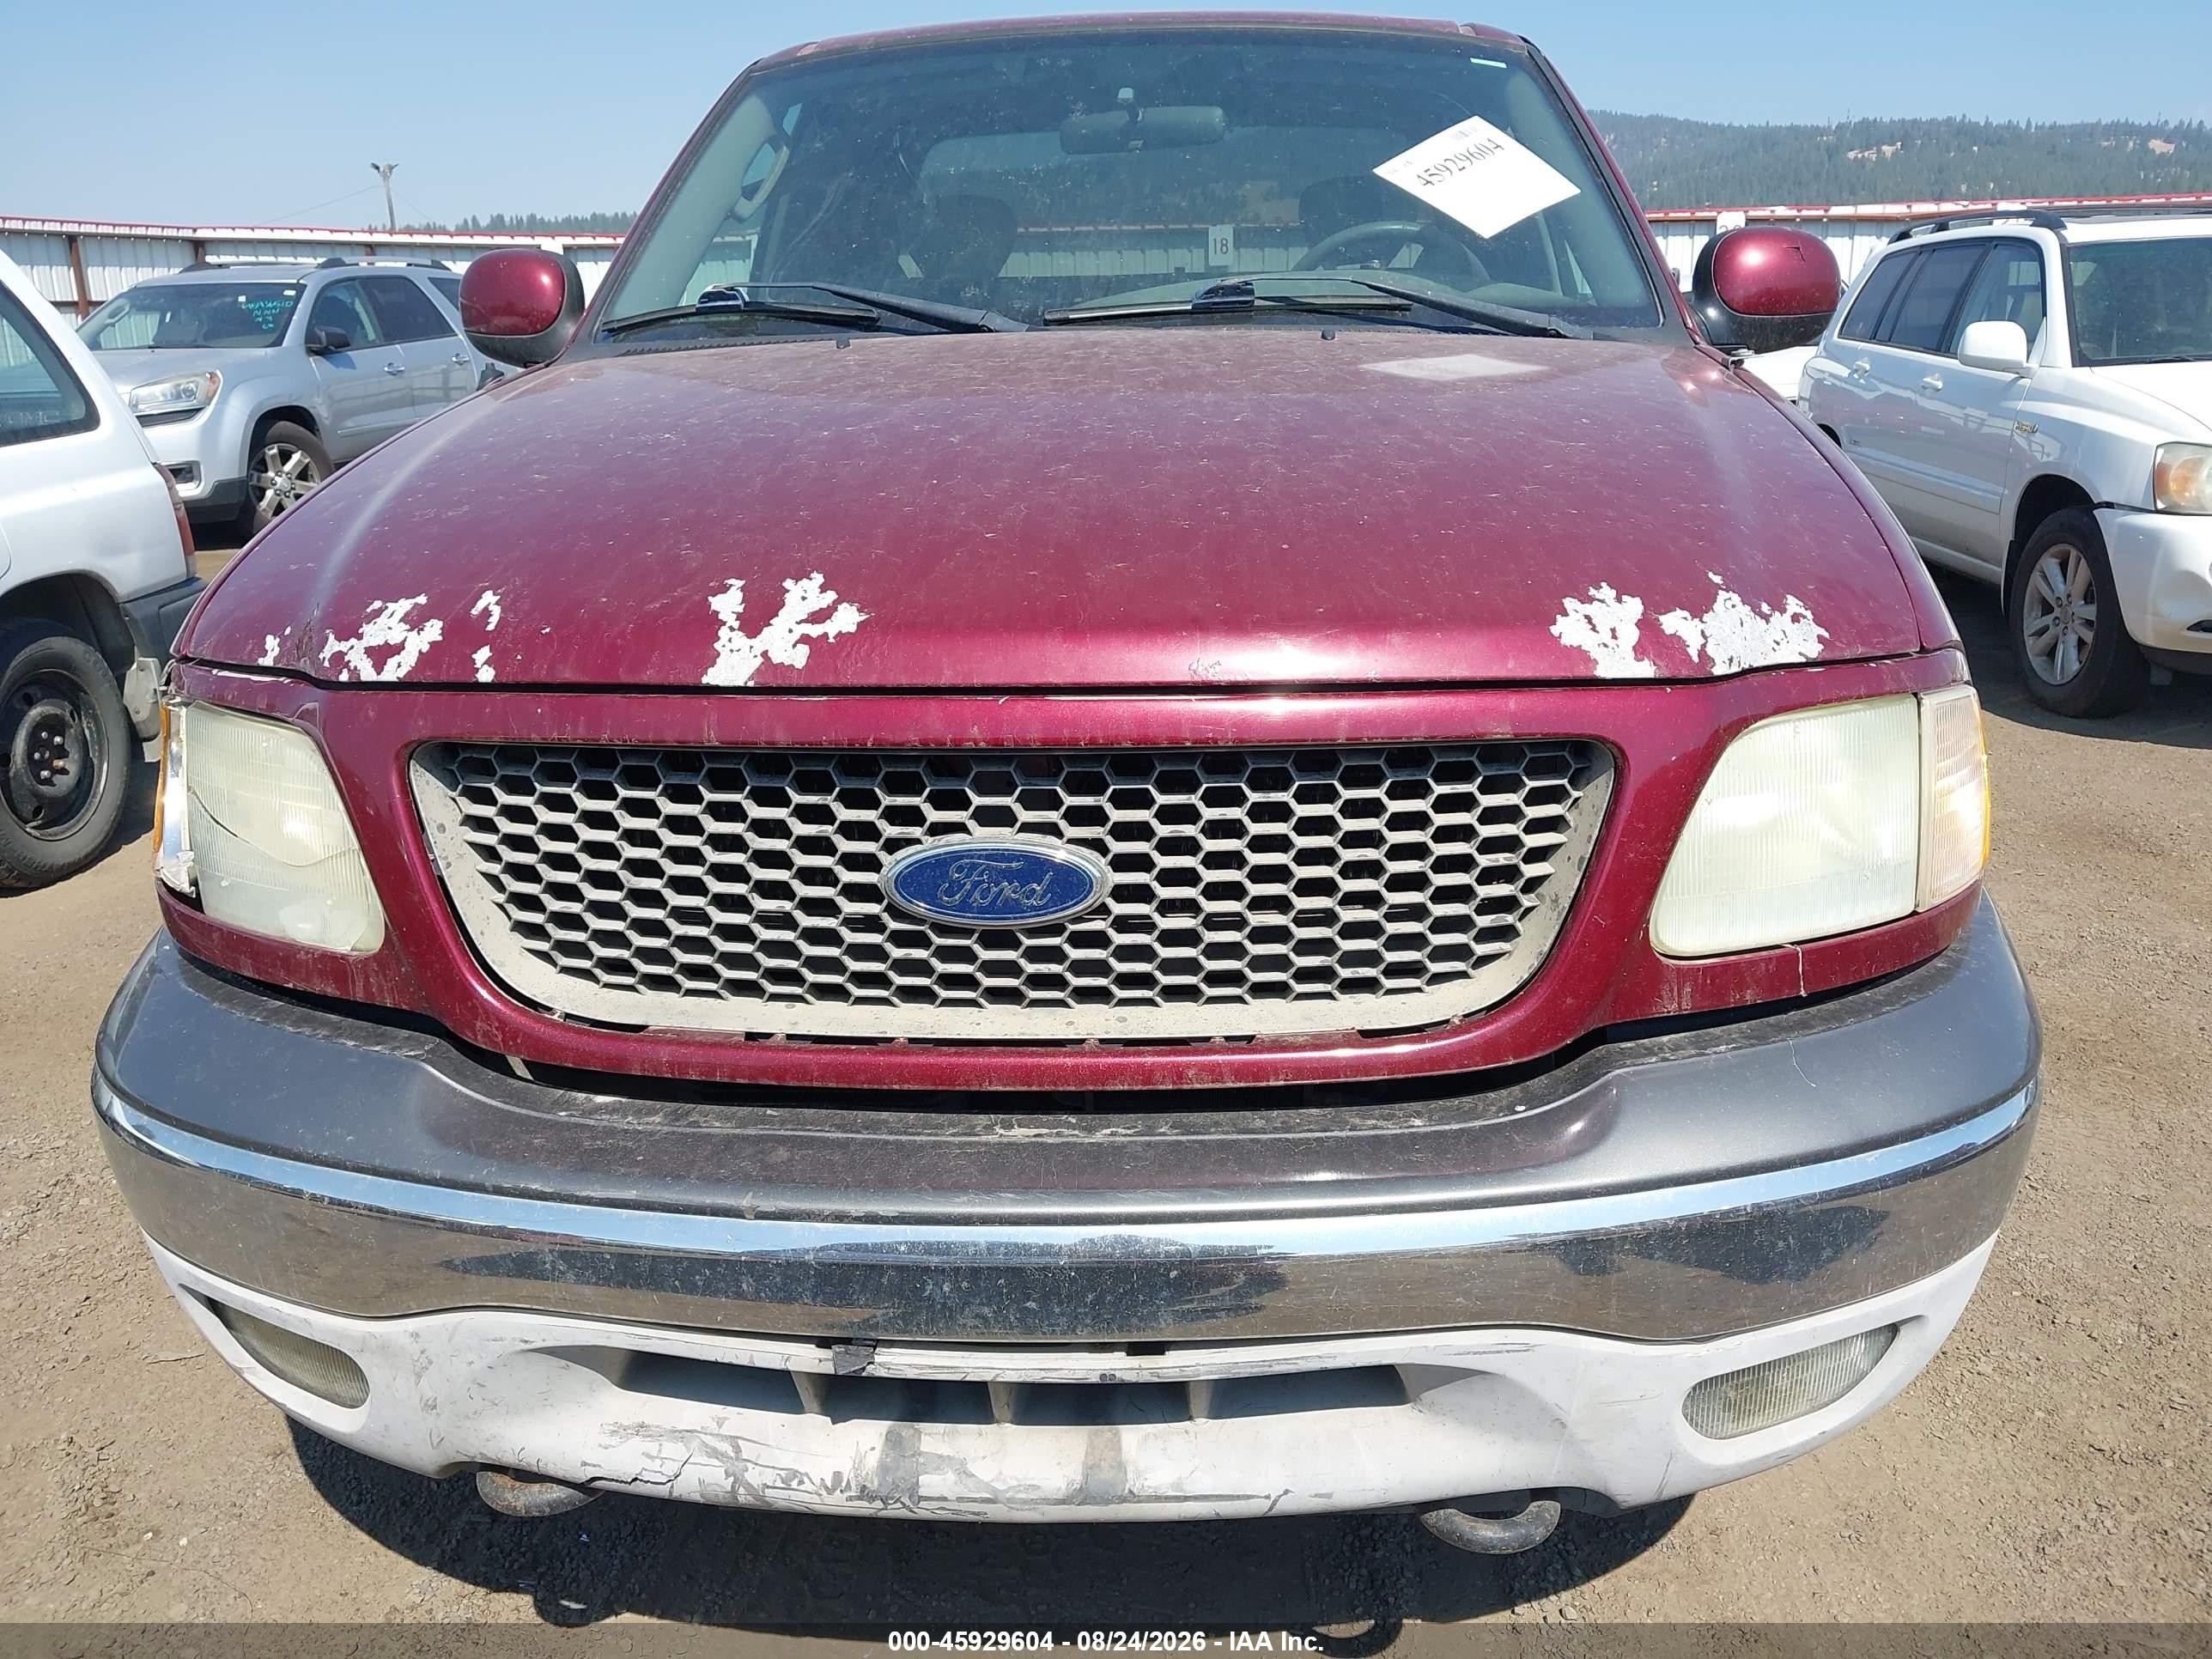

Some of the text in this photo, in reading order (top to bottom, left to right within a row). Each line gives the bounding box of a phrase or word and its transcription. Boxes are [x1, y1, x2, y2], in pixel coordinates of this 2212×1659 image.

[1415, 137, 1506, 187] 45929604
[1212, 237, 1230, 255] 18
[937, 859, 1055, 907] Ford
